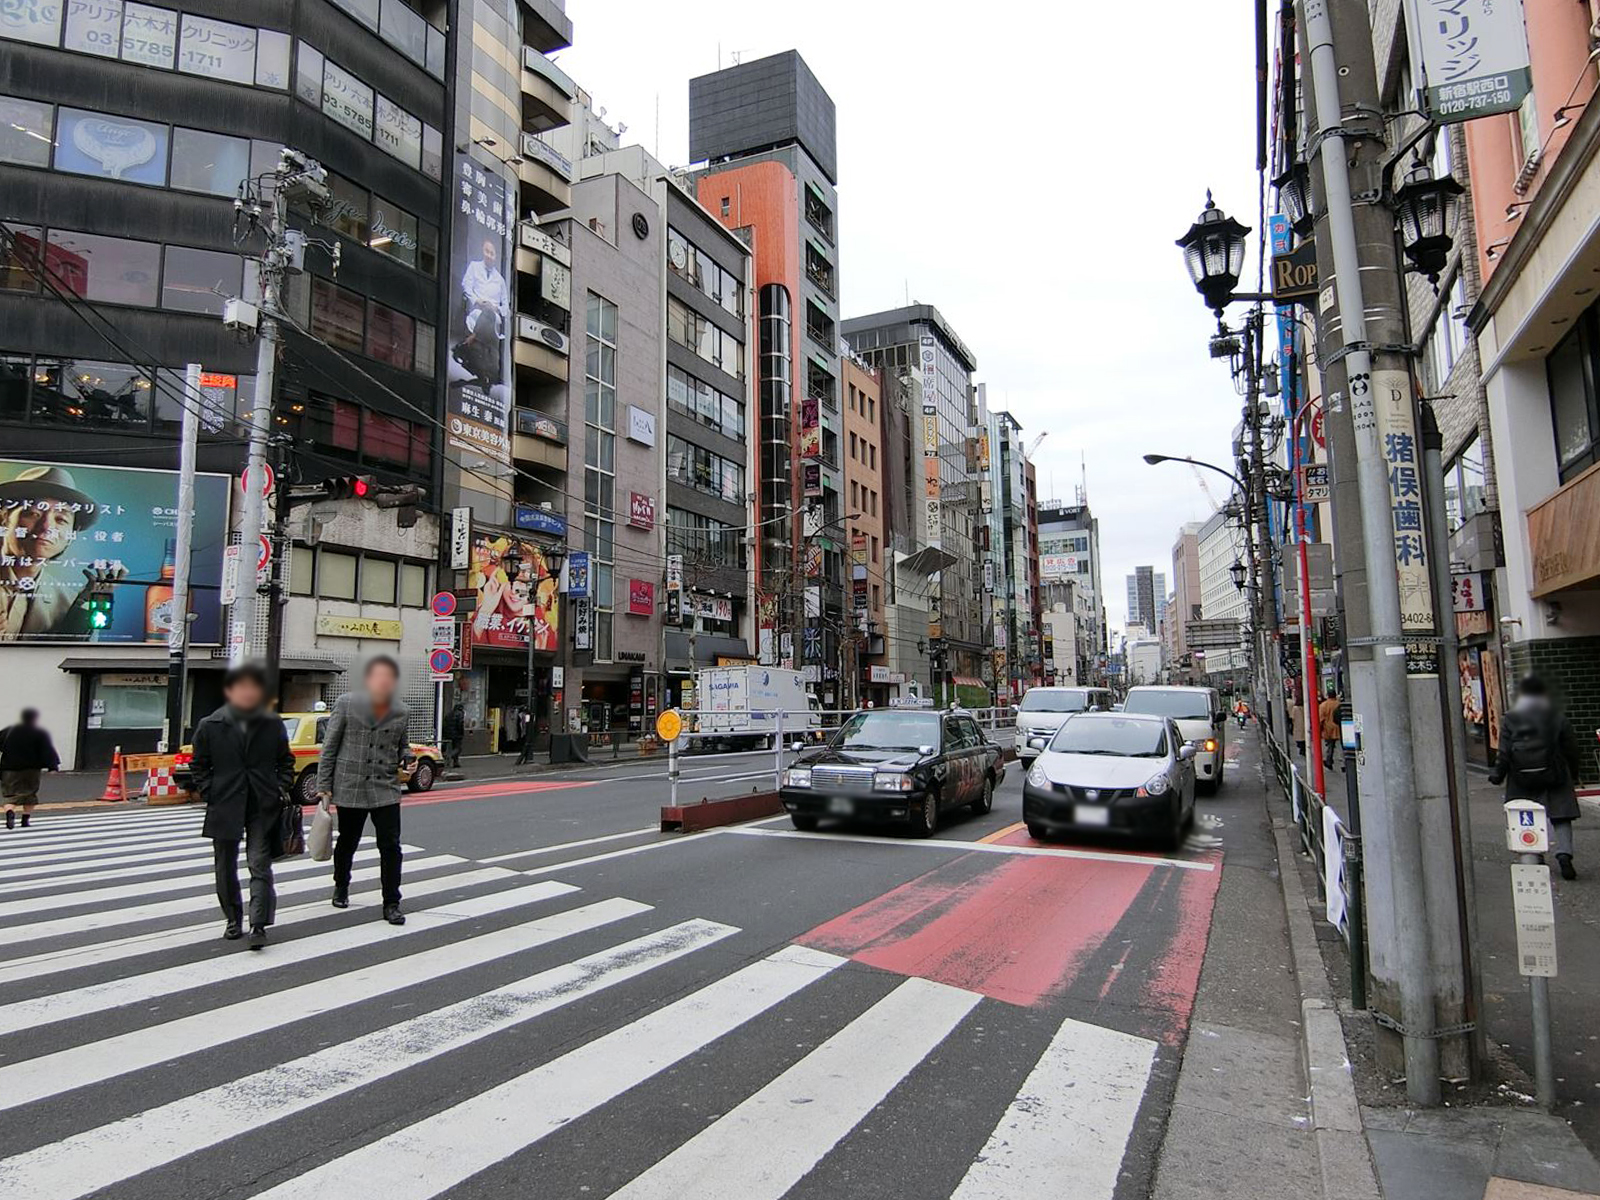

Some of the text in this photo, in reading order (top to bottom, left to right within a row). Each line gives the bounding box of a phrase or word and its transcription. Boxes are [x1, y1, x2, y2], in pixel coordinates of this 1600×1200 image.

[1438, 75, 1509, 102] 新宿駅西口
[1440, 90, 1511, 115] 0120-737-150
[1385, 432, 1425, 567] 猪俣歯科
